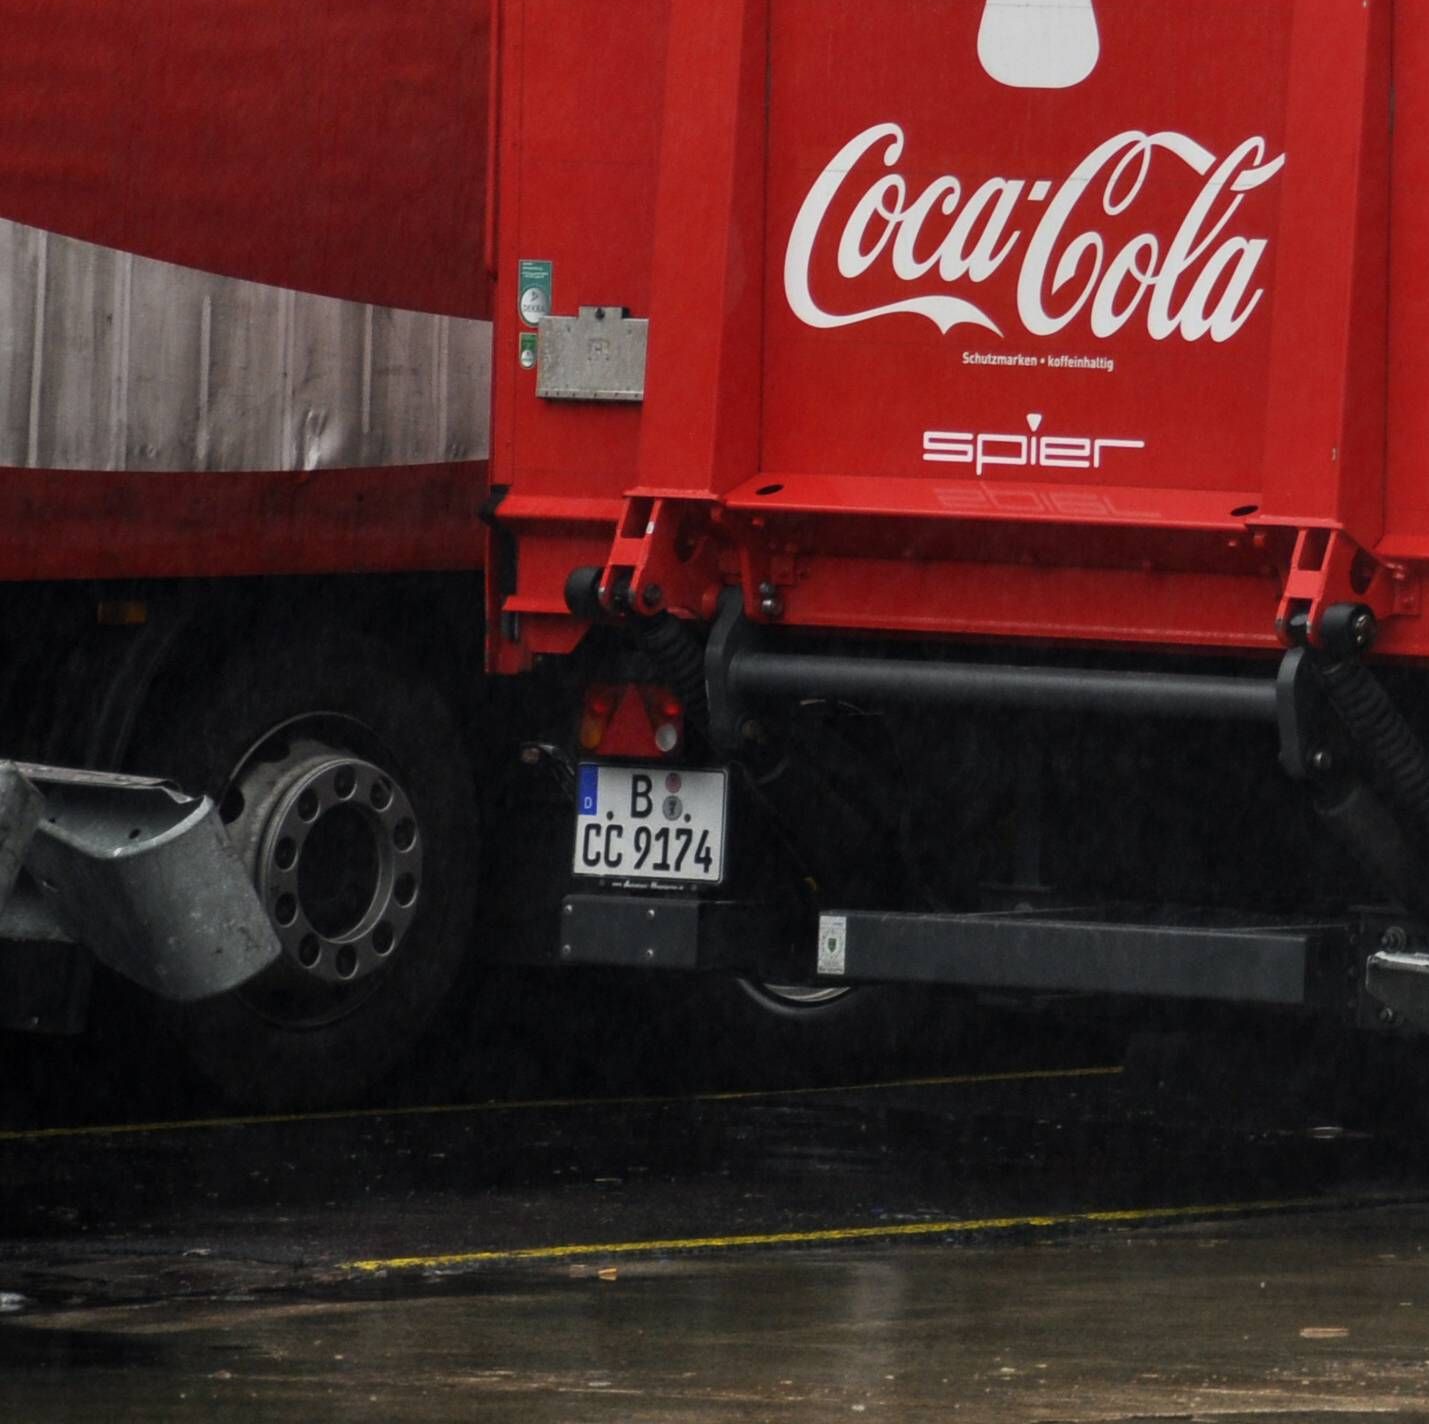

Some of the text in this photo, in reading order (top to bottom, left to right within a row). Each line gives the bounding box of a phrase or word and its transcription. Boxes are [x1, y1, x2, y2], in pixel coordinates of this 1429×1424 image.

[784, 122, 1286, 343] Coca-Cola
[962, 351, 1114, 372] Schutzmarken koffeinhaltig
[922, 413, 1145, 476] spier
[584, 773, 653, 819] D B
[582, 823, 713, 874] CC 9174
